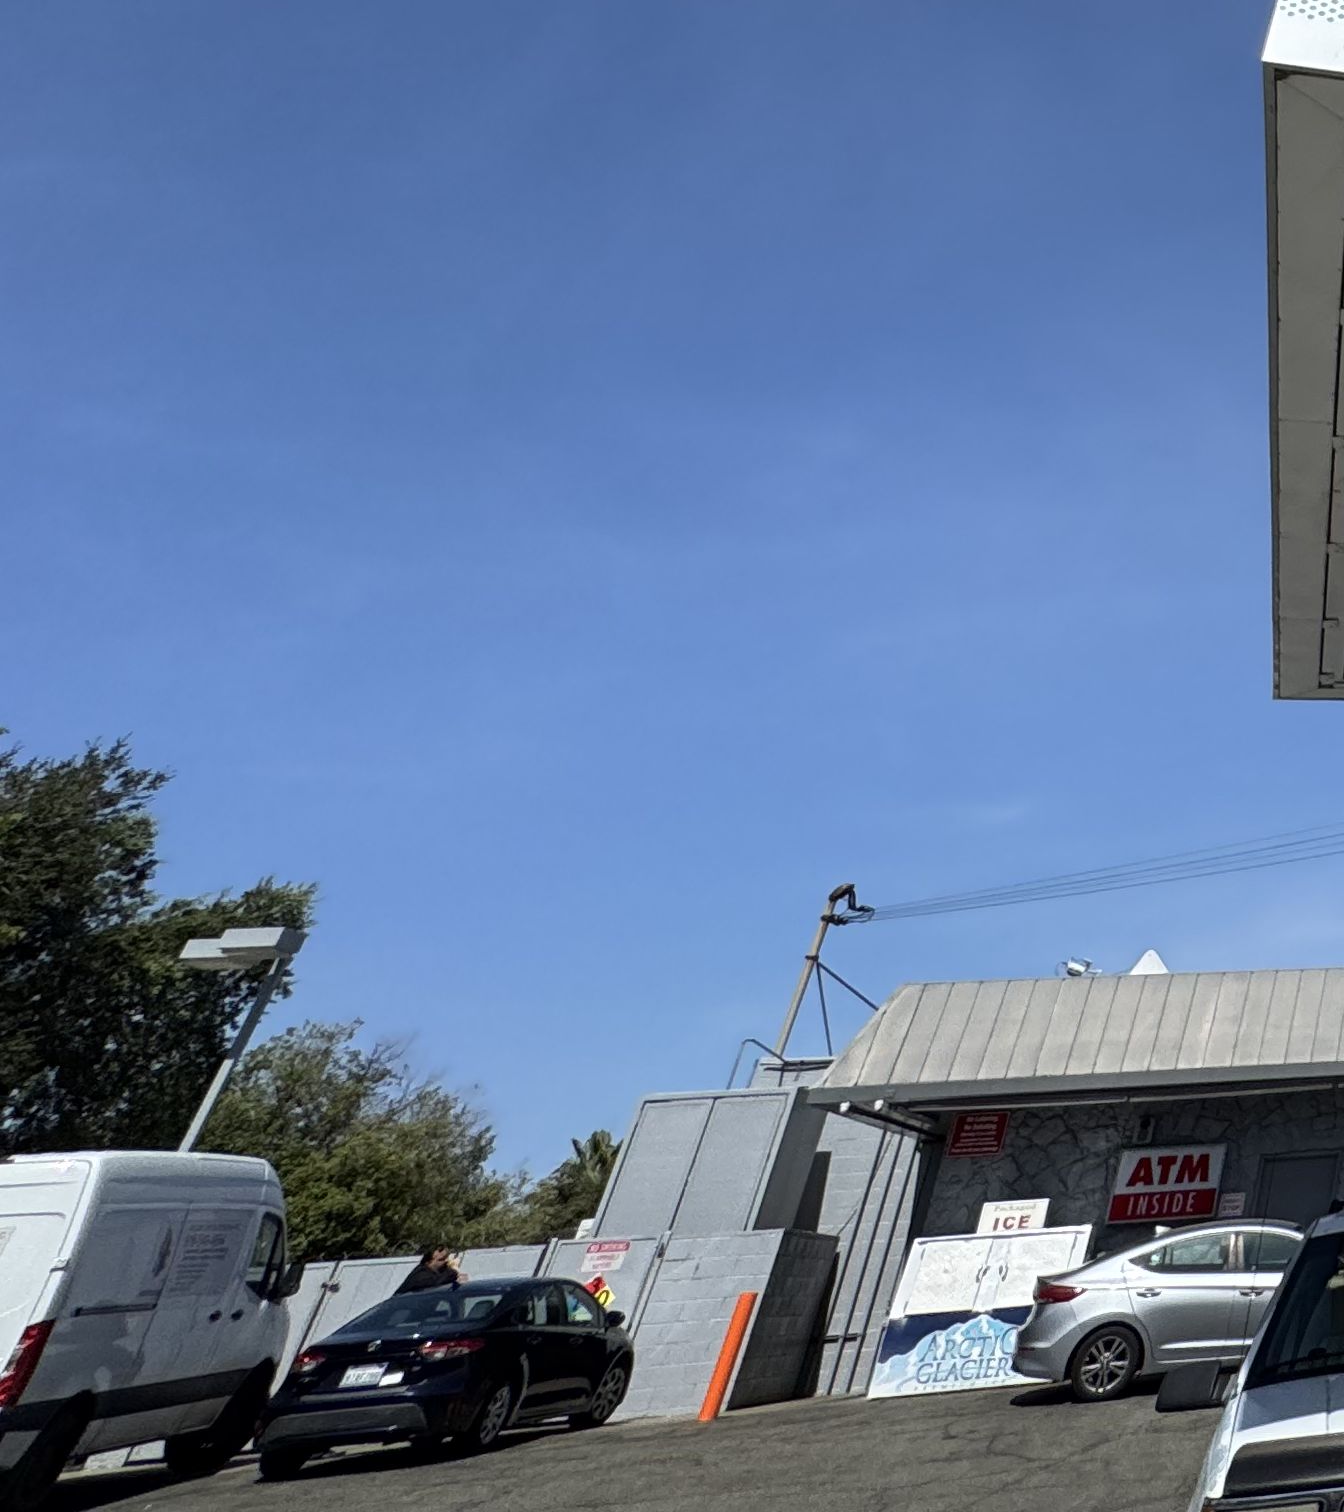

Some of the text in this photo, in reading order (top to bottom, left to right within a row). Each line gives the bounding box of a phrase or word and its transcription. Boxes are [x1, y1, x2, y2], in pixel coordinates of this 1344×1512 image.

[1126, 1153, 1210, 1187] ATM
[1126, 1192, 1197, 1216] INSIDE
[992, 1214, 1031, 1231] ICE
[918, 1327, 1018, 1363] ARCTIC
[915, 1356, 1010, 1384] GLACIER
